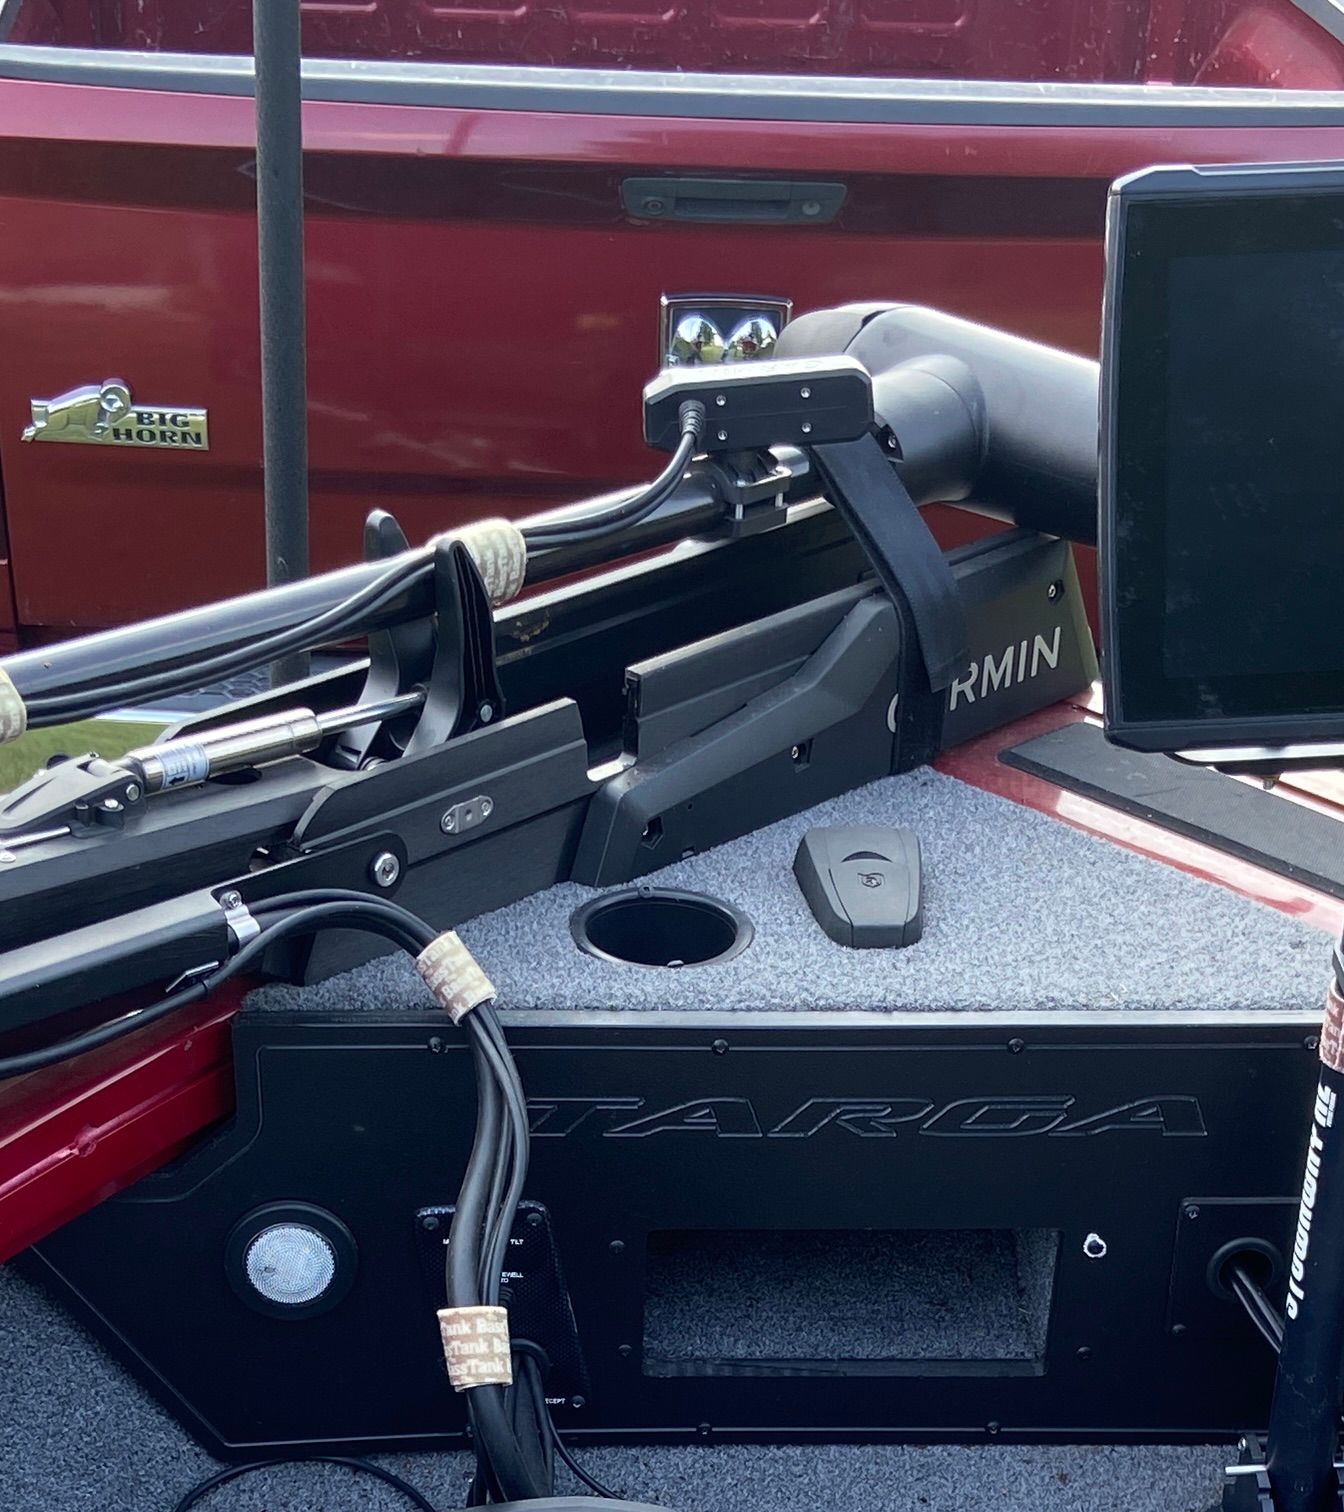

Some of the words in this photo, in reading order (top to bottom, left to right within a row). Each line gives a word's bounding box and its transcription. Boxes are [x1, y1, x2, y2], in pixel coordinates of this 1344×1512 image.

[136, 412, 190, 428] BIG
[112, 427, 203, 446] HORN
[885, 626, 1061, 733] RMIN
[526, 1095, 1208, 1138] TARGA
